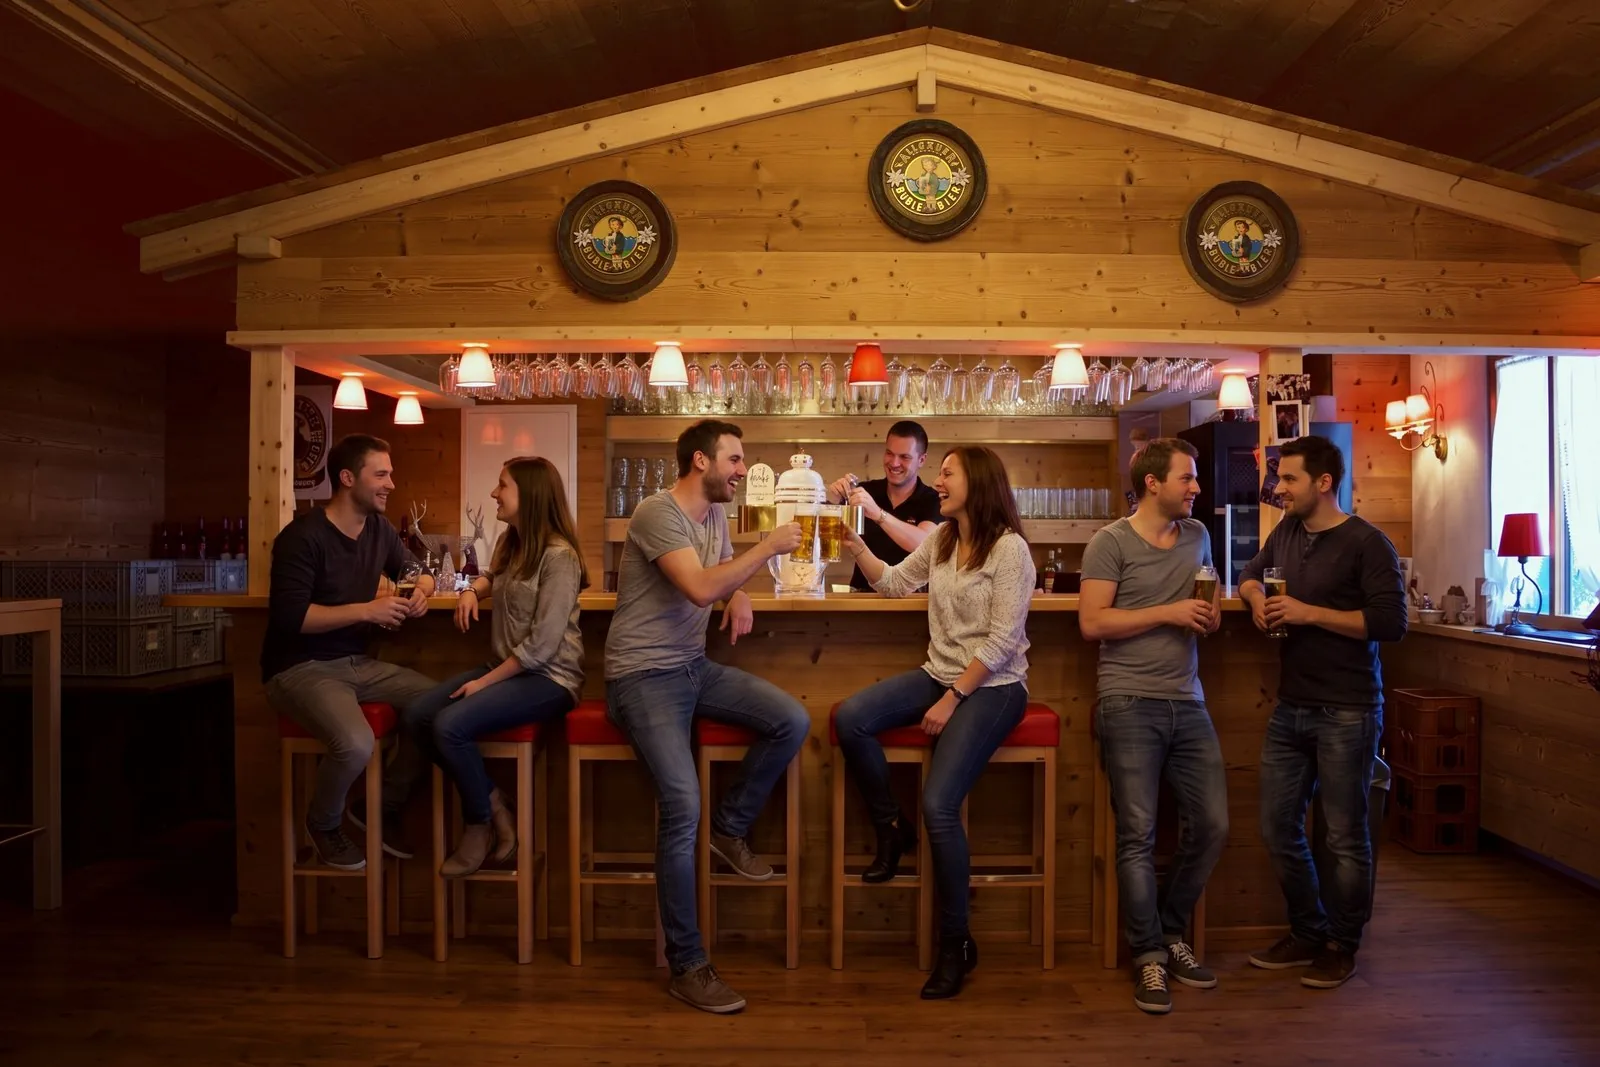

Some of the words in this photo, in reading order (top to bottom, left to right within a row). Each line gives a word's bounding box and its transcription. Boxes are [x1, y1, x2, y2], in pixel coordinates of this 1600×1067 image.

[937, 186, 961, 211] BIER
[623, 244, 647, 268] BIER
[1250, 248, 1273, 273] BIER
